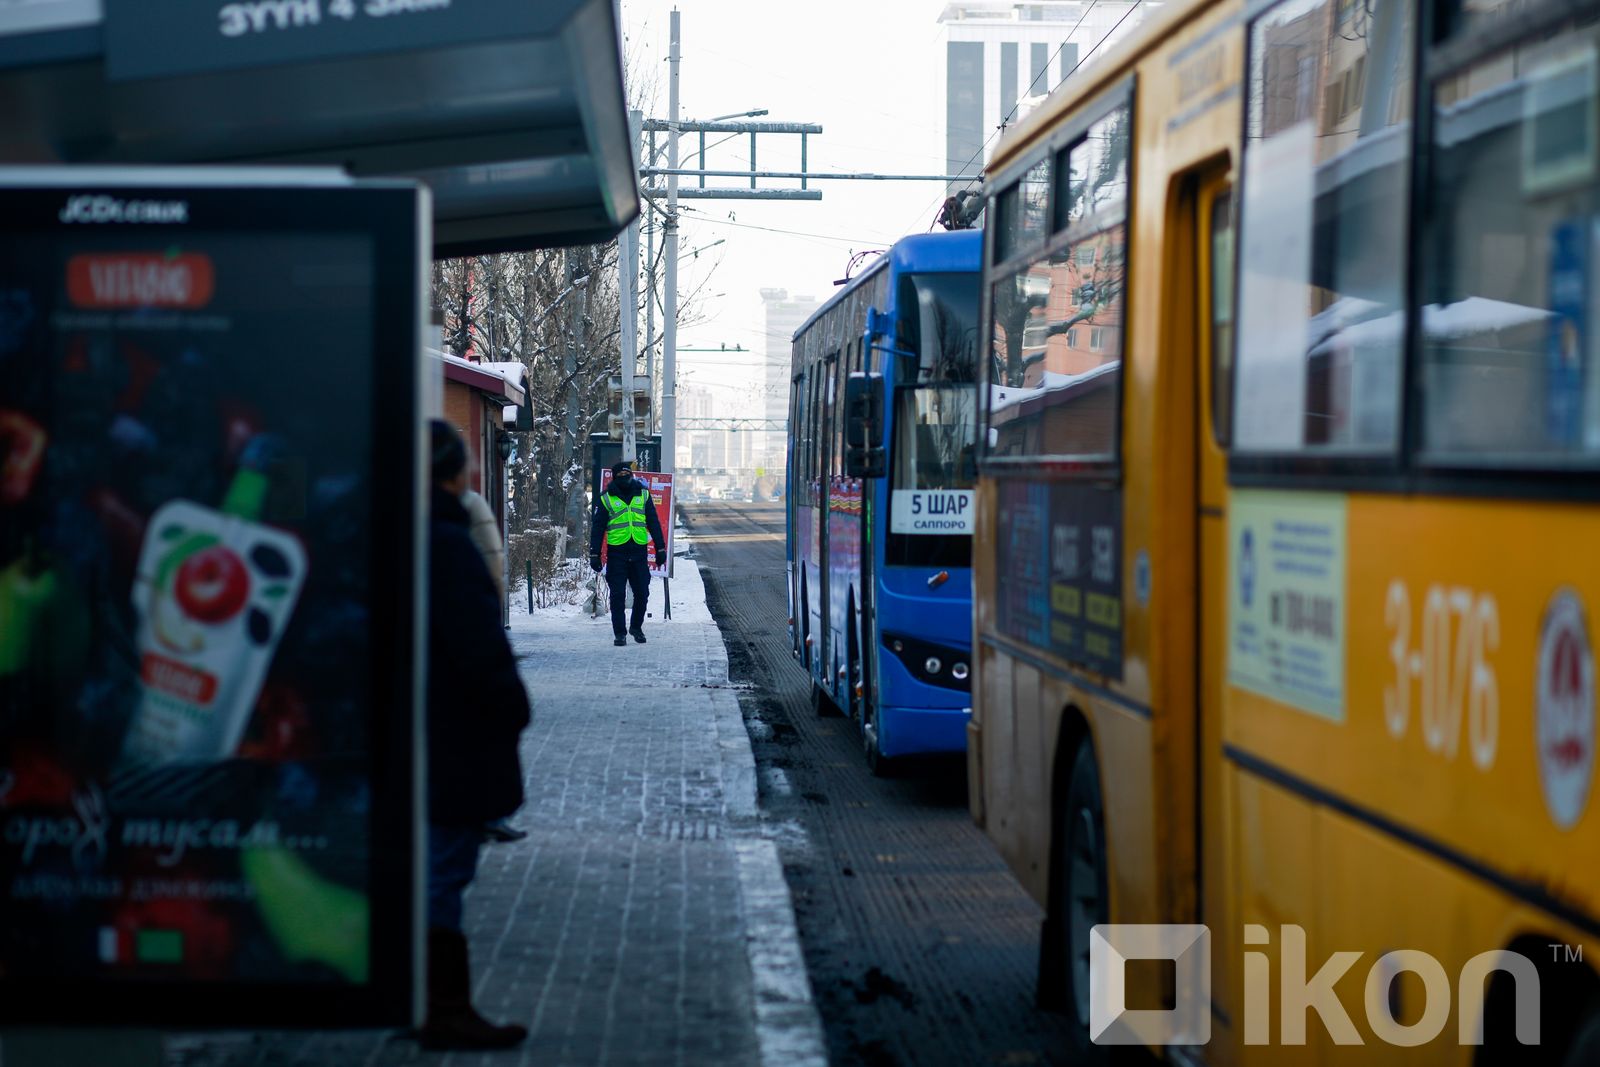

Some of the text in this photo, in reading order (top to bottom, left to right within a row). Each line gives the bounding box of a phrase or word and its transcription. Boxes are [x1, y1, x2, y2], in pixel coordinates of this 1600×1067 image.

[911, 494, 969, 515] 5 ШАР
[913, 520, 966, 530] САППОРО
[1384, 577, 1500, 773] 3-076
